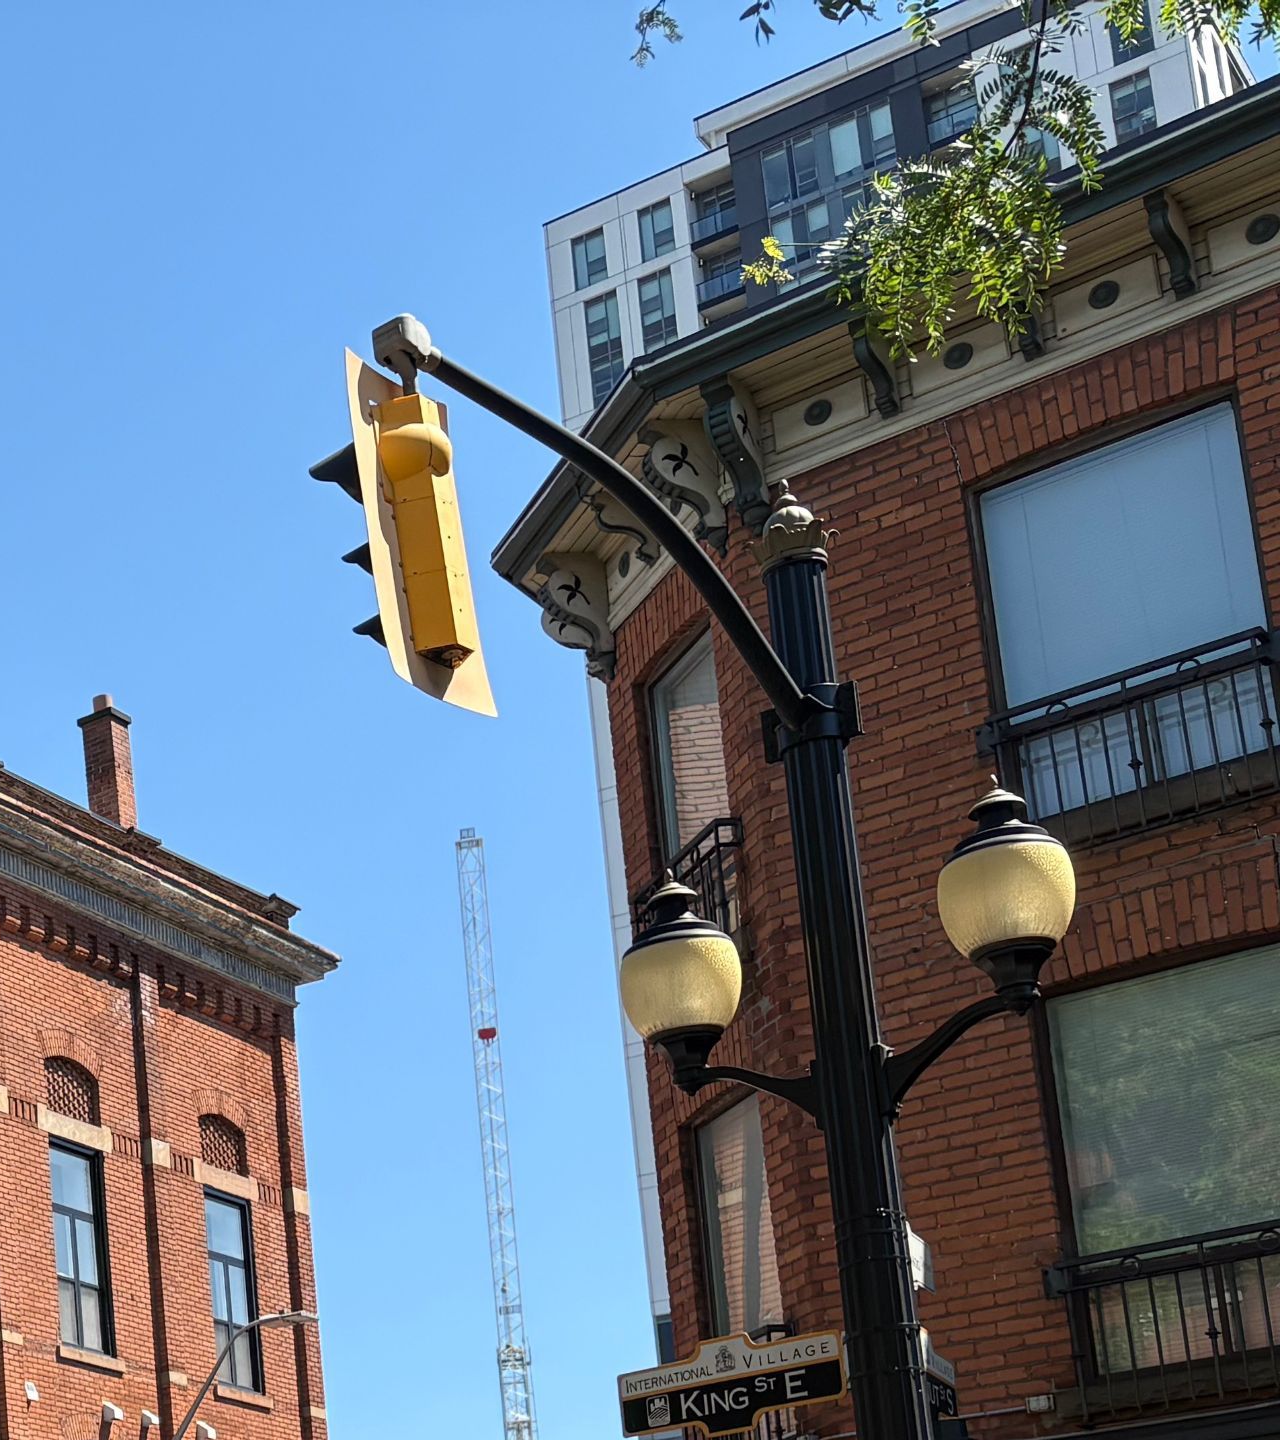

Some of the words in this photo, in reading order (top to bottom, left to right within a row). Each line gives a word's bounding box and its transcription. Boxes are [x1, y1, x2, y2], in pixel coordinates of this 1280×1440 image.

[624, 1365, 713, 1394] INTERNATIONAL
[742, 1341, 831, 1370] VILLAGE
[679, 1387, 749, 1421] KING
[785, 1369, 809, 1400] E
